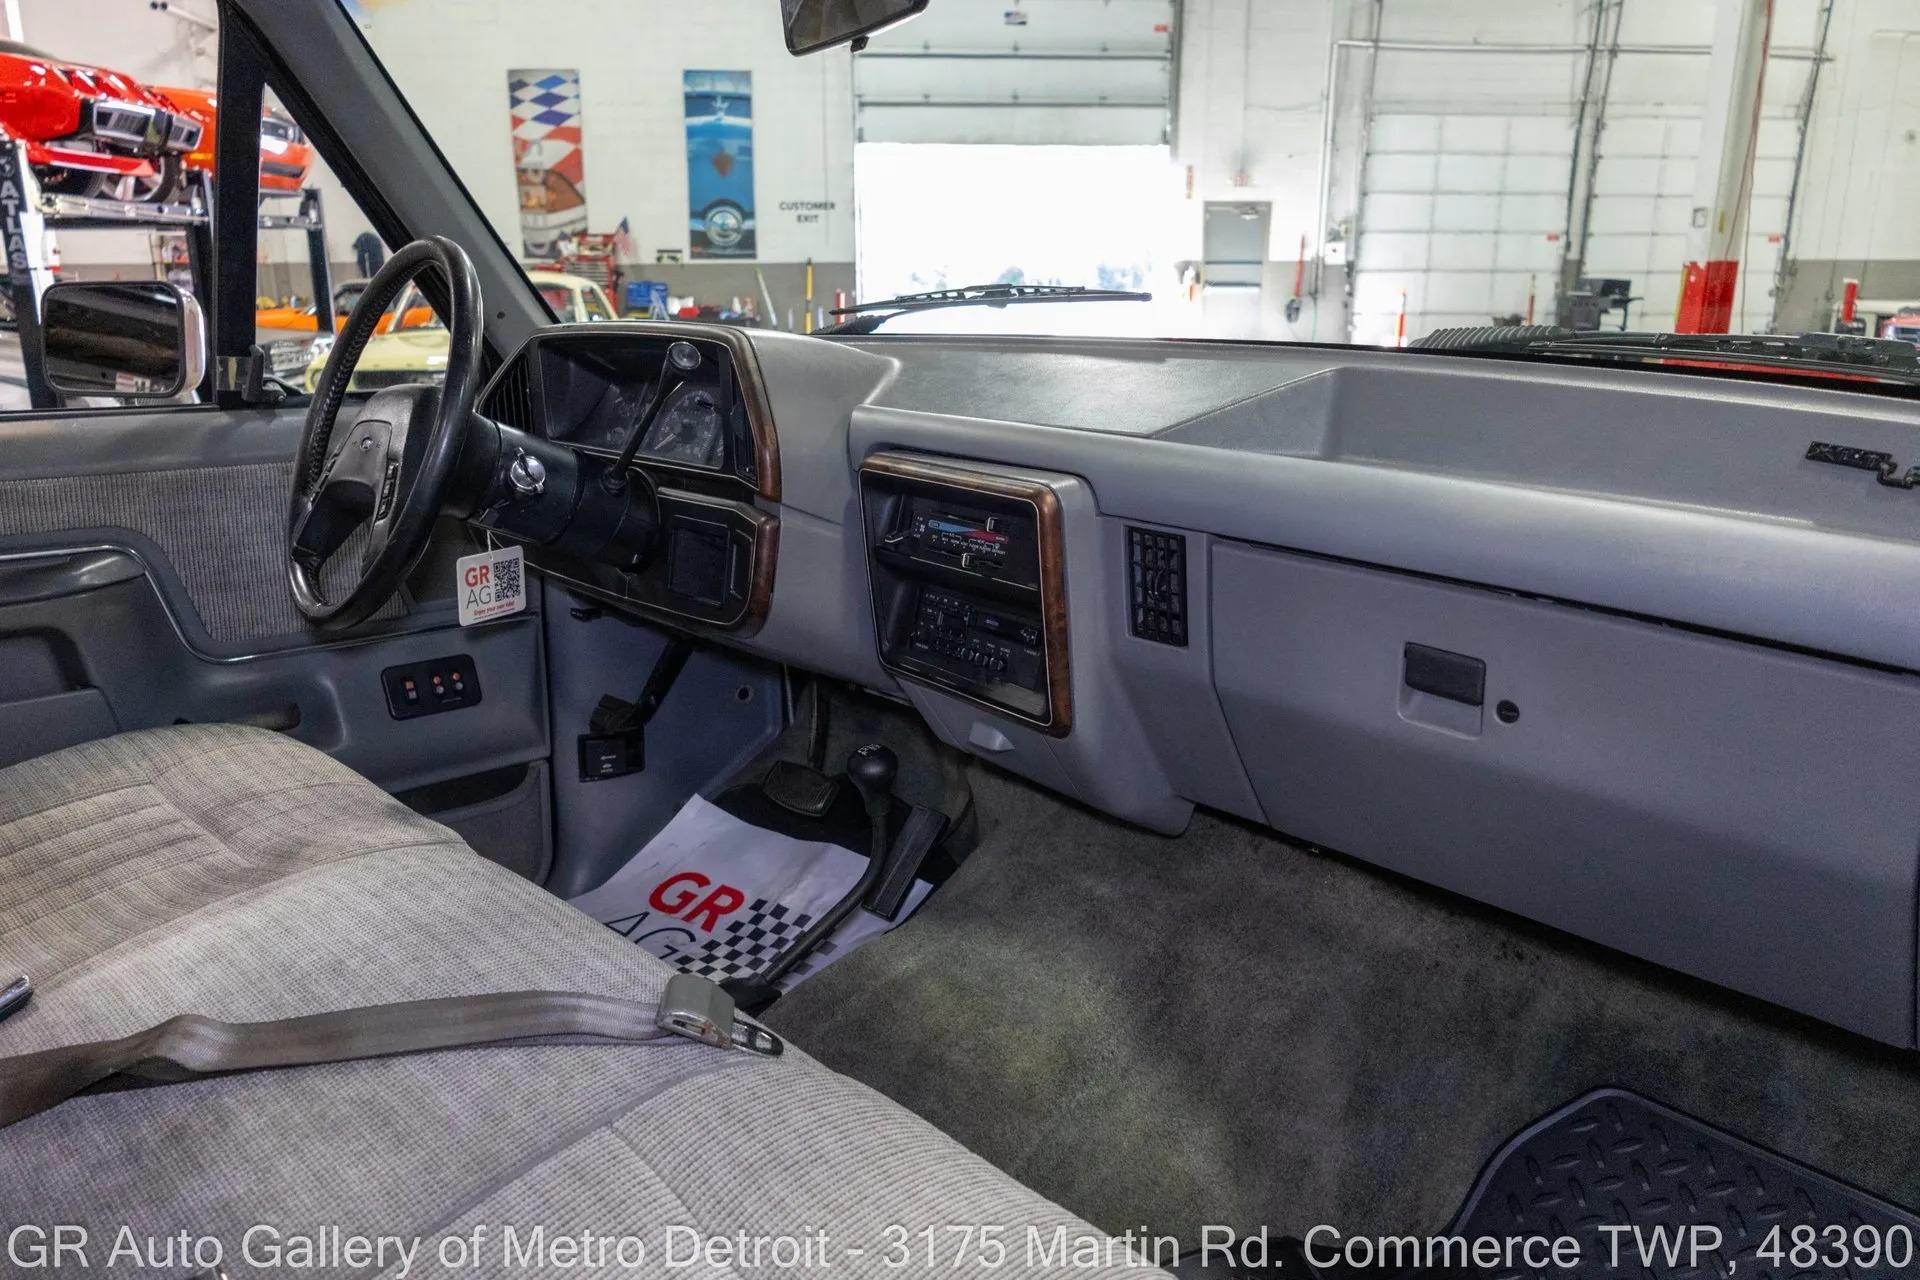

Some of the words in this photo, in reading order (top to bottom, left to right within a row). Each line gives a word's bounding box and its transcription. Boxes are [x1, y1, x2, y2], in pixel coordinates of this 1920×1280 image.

[779, 201, 836, 211] CUSTOMER
[0, 180, 28, 269] ATLAS
[797, 214, 819, 223] EXIT
[464, 565, 491, 588] GR
[466, 585, 492, 609] AG
[649, 872, 745, 933] GR
